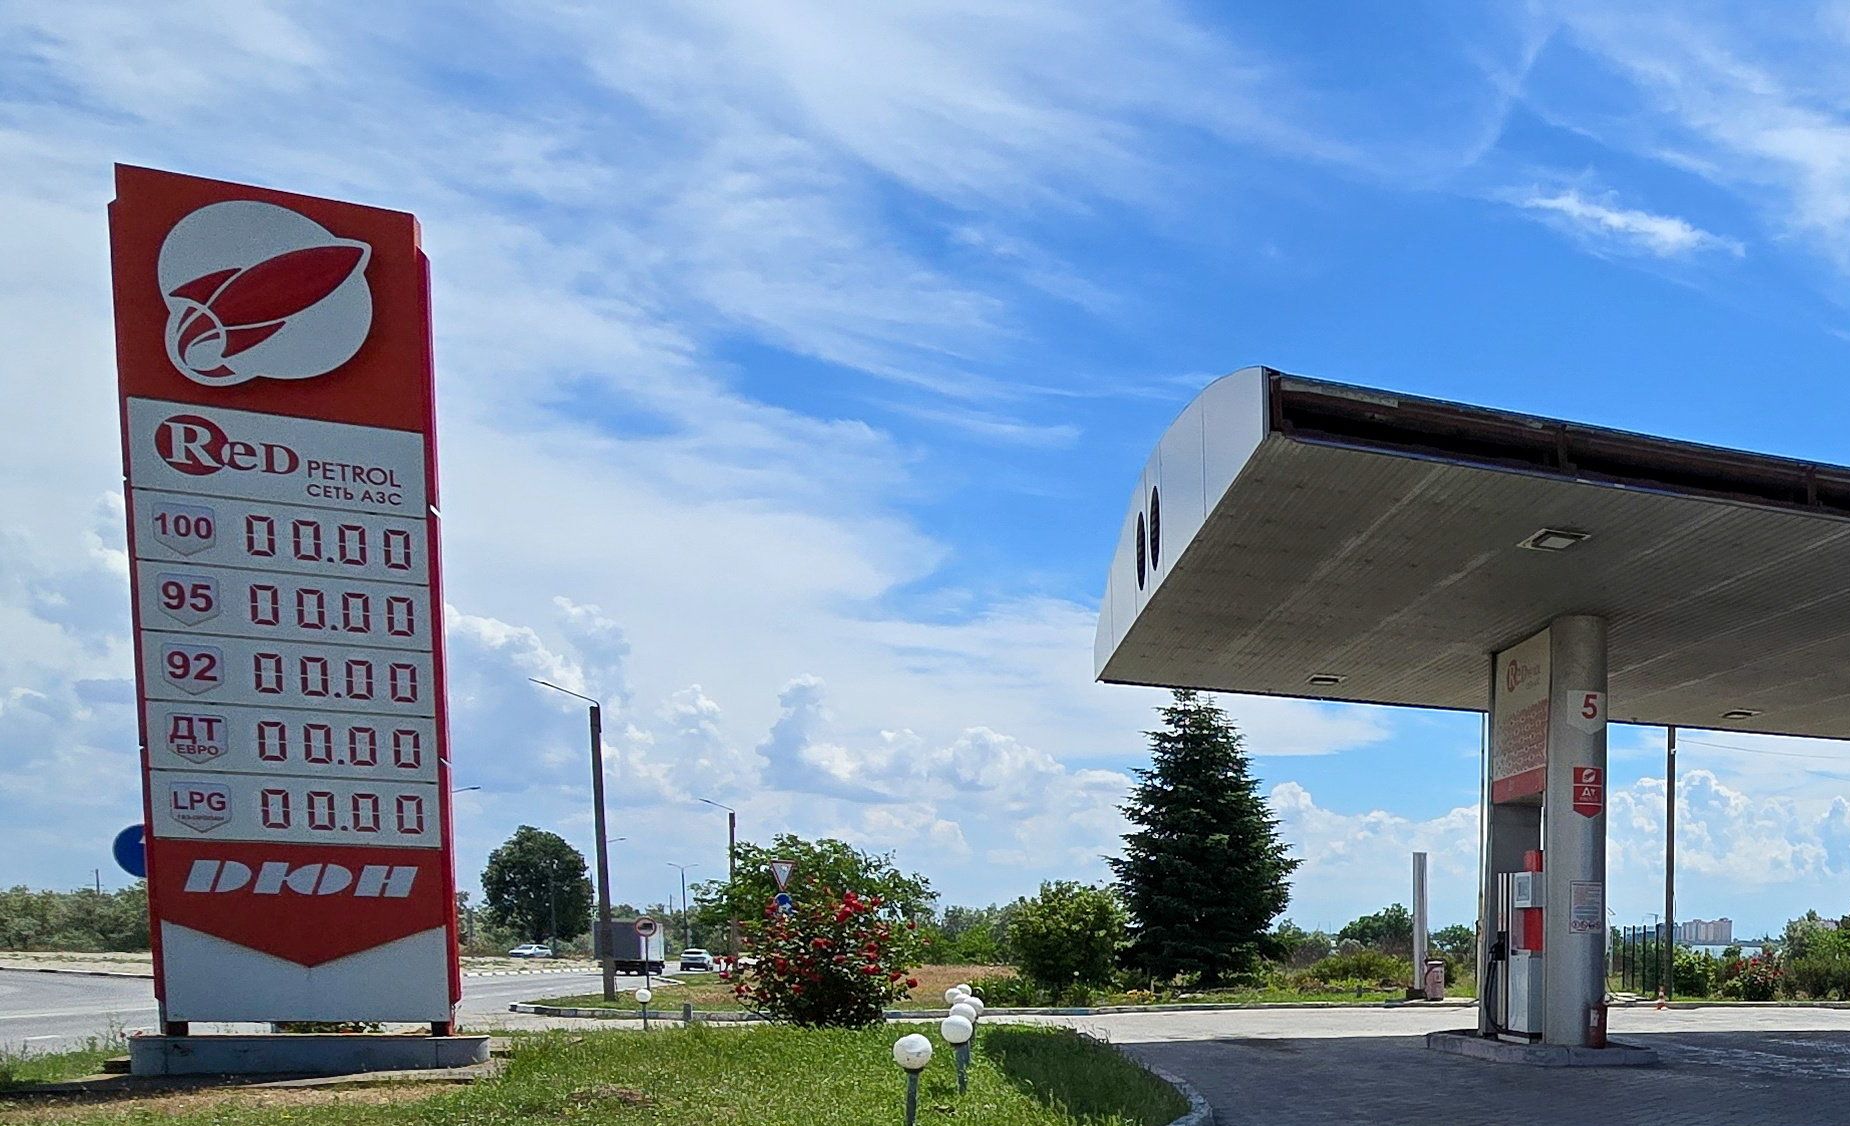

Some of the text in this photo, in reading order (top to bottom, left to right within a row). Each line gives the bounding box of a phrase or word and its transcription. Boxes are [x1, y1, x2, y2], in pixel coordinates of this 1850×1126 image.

[307, 459, 402, 489] PETROL
[306, 483, 403, 506] СЕТЬ АЗС
[154, 512, 212, 540] 100
[161, 580, 214, 613] 95
[166, 650, 218, 682] 92
[1581, 693, 1598, 720] 5
[169, 715, 222, 744] ДТ
[176, 743, 219, 756] ЕВРО
[173, 790, 226, 812] LPG
